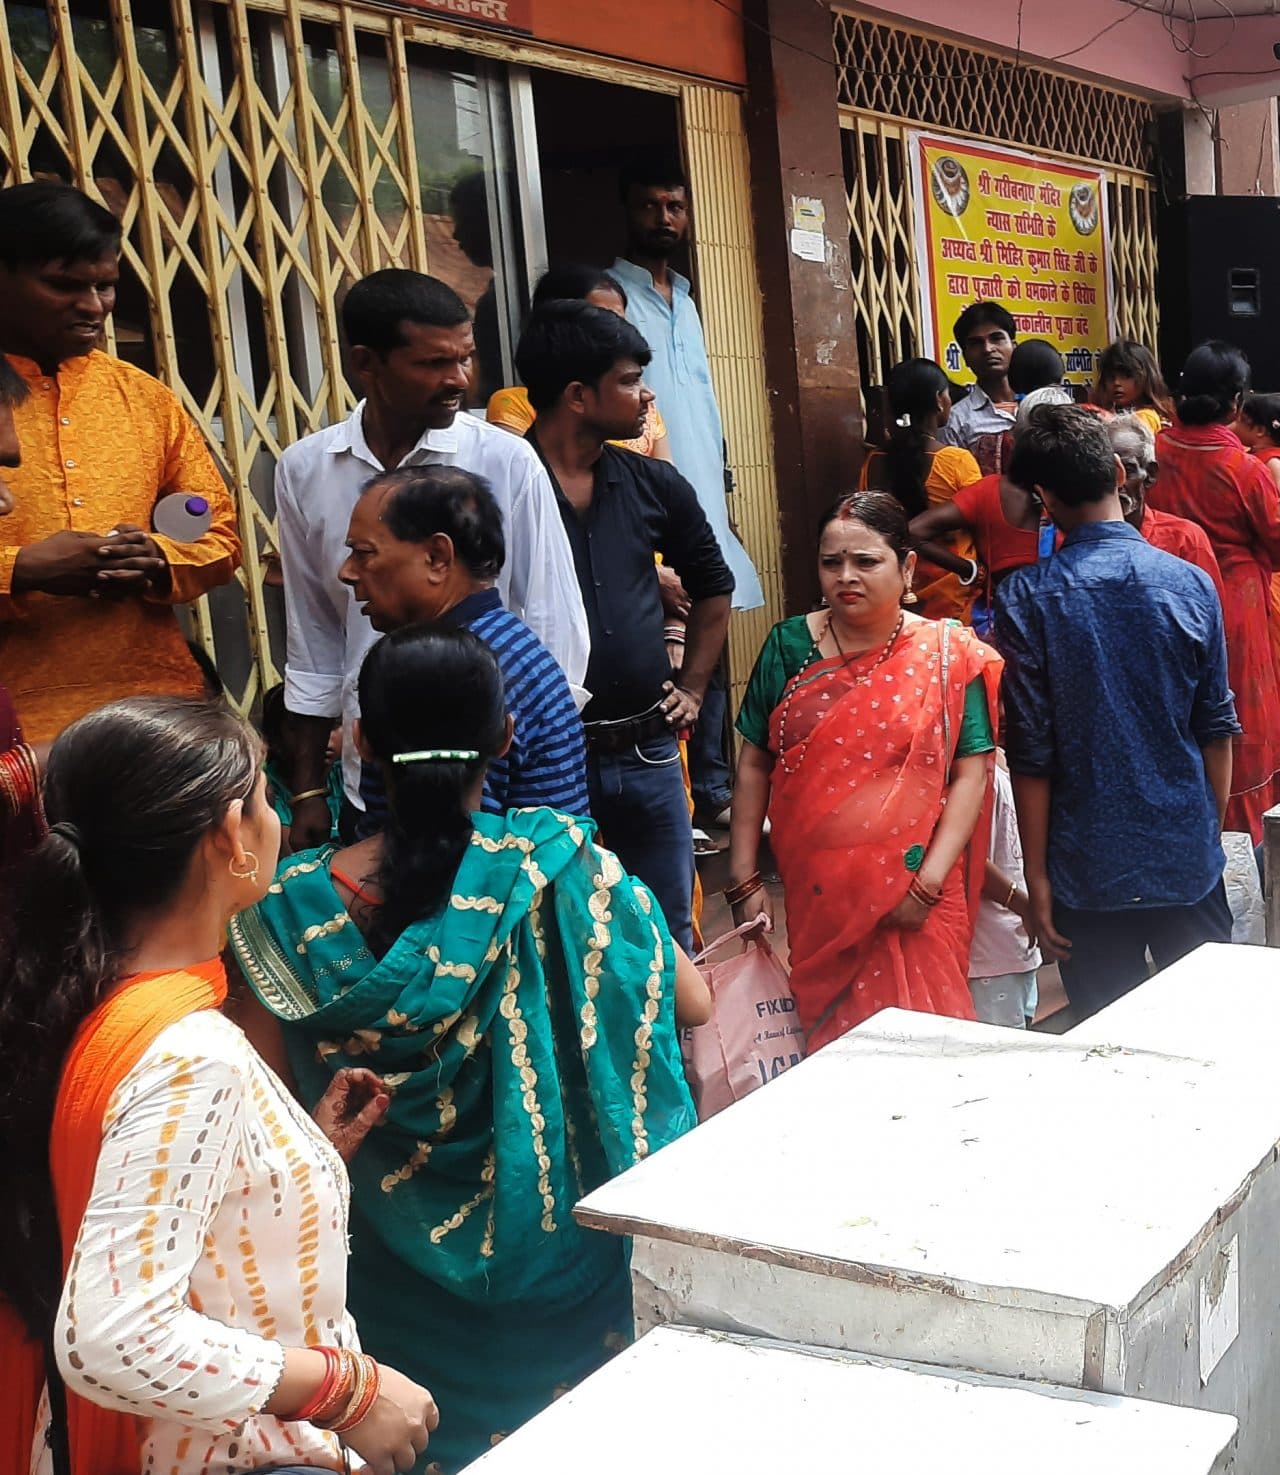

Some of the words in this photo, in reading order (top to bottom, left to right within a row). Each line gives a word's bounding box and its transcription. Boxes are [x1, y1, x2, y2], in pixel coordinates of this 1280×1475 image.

[978, 171, 991, 195] श्री
[994, 176, 1036, 204] गरीबनाथ
[1039, 183, 1061, 207] मंदिर
[987, 211, 1012, 233] न्यास
[1014, 212, 1044, 237] समिति
[1047, 217, 1056, 238] के
[942, 239, 976, 261] अध्यक्ष
[980, 240, 993, 264] श्री
[997, 242, 1024, 267] मिहिर
[1027, 250, 1051, 275] कुमार
[1054, 248, 1070, 271] सिंह
[1072, 251, 1086, 273] जी
[1089, 254, 1098, 274] के
[947, 274, 969, 296] द्वारा
[973, 274, 1003, 302] पुजारी
[1007, 276, 1021, 300] को
[1026, 280, 1058, 303] धमकाने
[1061, 282, 1070, 303] के
[1073, 284, 1096, 305] विरोध
[1014, 313, 1052, 334] तकालीन
[1056, 315, 1072, 339] पूजा
[1075, 317, 1088, 336] बंद
[947, 342, 961, 372] श्री
